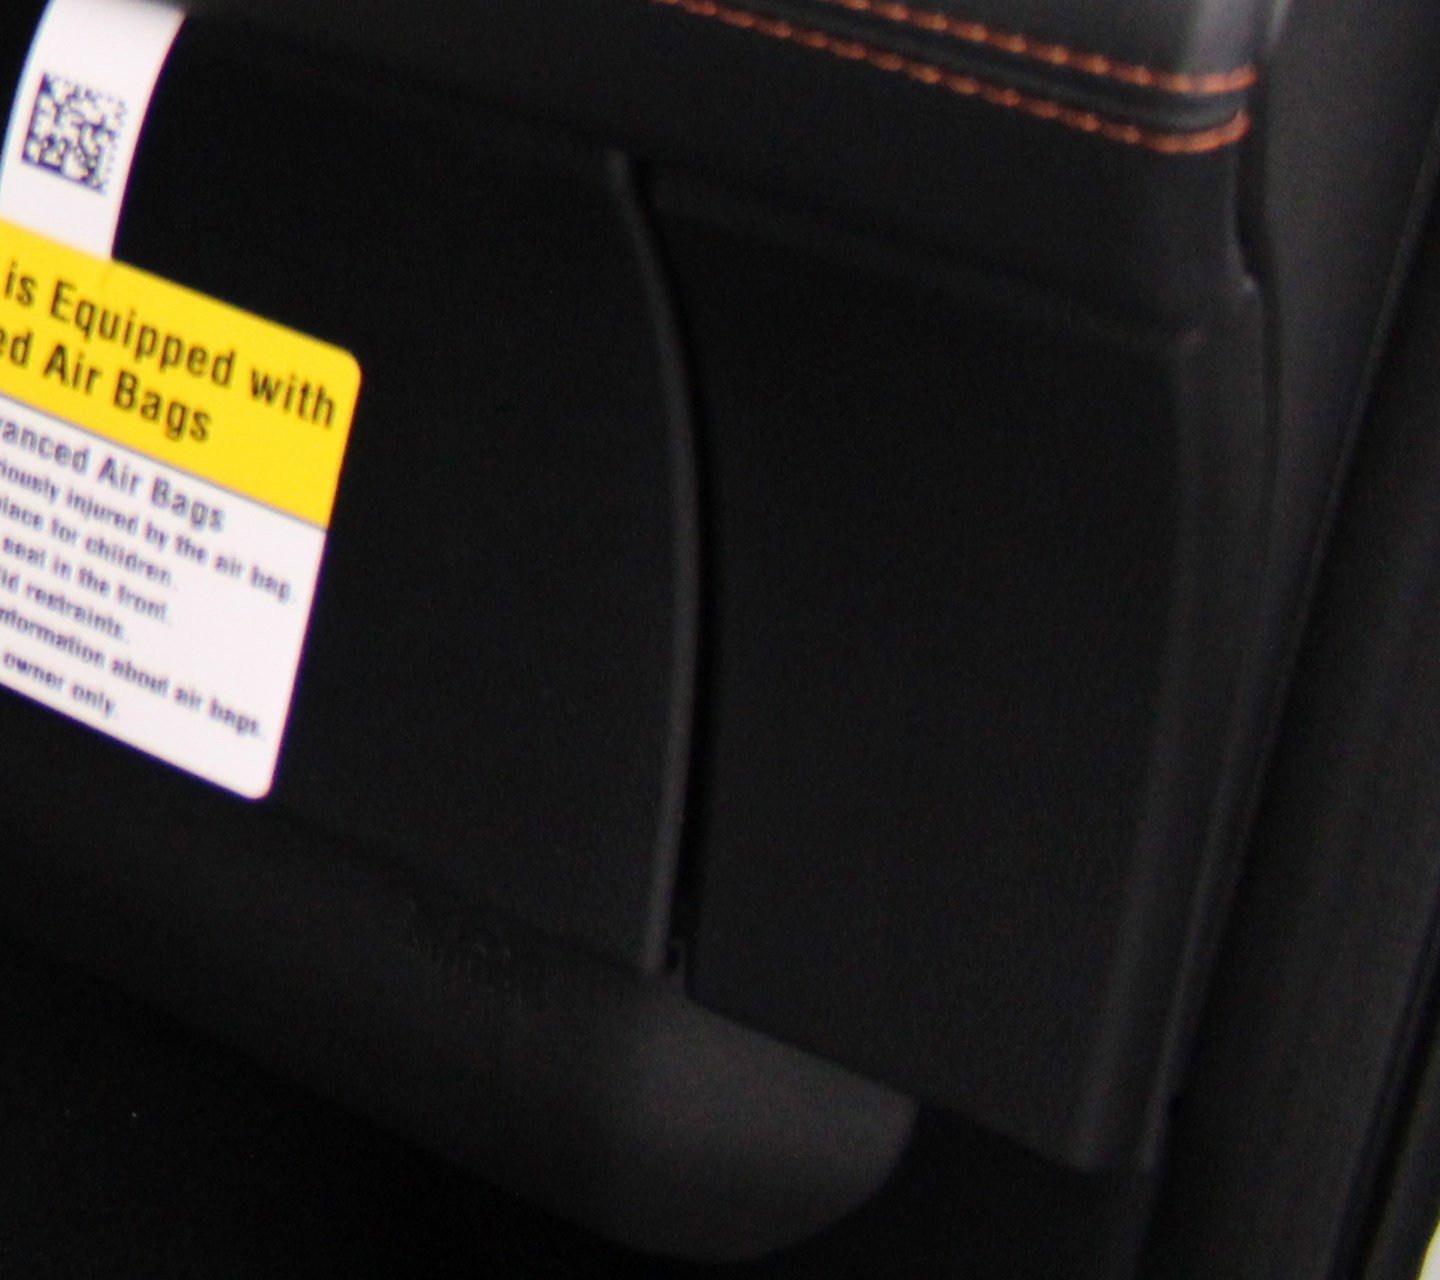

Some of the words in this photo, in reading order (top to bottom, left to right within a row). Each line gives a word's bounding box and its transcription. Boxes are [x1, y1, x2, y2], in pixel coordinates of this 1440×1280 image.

[2, 260, 37, 307] is
[48, 278, 236, 387] Equipped
[249, 367, 335, 428] with
[42, 341, 101, 394] Air
[111, 368, 210, 441] Bags
[96, 455, 140, 494] Air
[149, 475, 223, 531] Bags
[49, 515, 78, 544] for
[64, 487, 139, 534] injured
[142, 520, 168, 551] by
[173, 533, 207, 564] the
[213, 553, 243, 576] air
[1, 535, 46, 567] seat
[51, 554, 71, 579] in
[76, 566, 110, 596] the
[2, 651, 64, 688] owner
[110, 657, 168, 695] about
[173, 686, 202, 709] air
